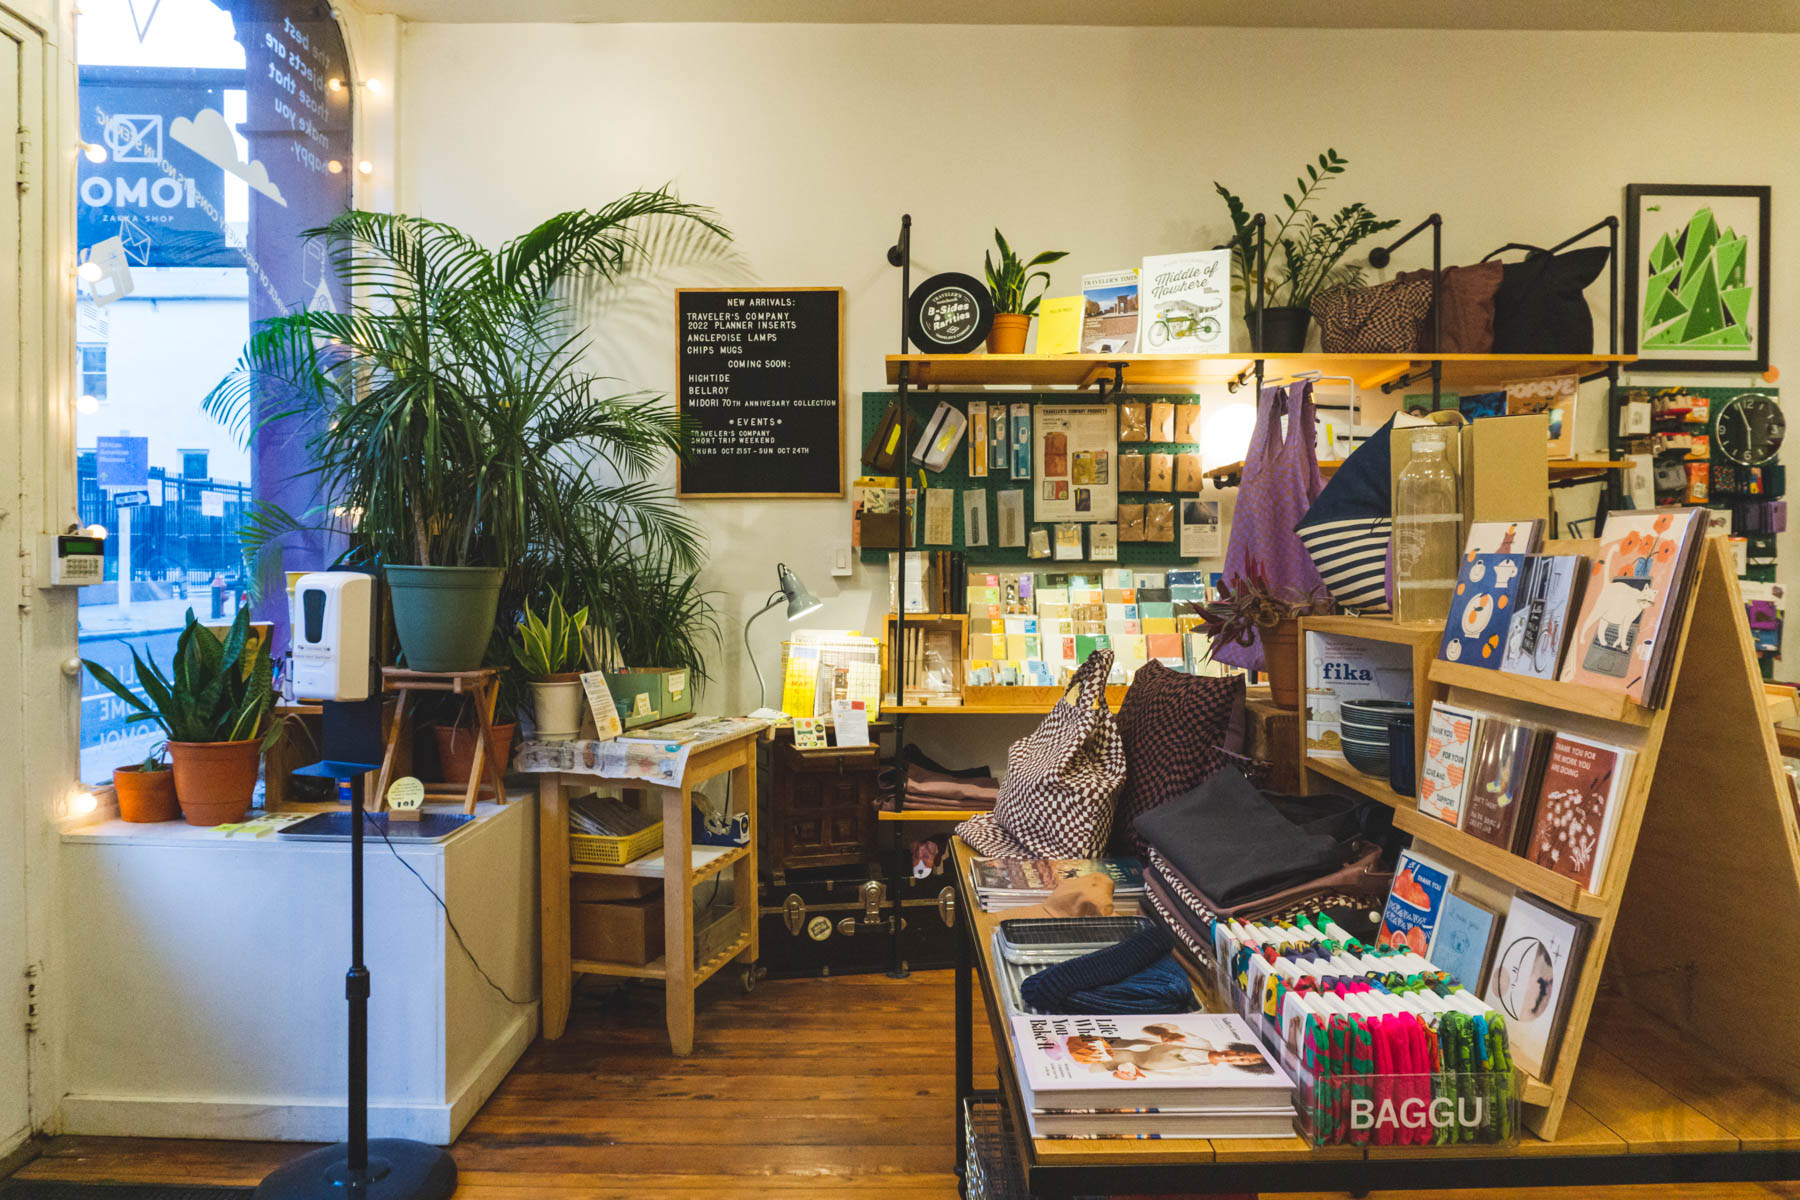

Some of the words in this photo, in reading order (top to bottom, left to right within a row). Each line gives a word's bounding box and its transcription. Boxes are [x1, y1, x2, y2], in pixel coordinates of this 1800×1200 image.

[80, 176, 196, 209] OMOI
[145, 215, 175, 223] SHOP
[1155, 267, 1200, 287] Middle
[1203, 260, 1219, 278] of
[1151, 279, 1208, 299] Nowhere
[727, 298, 746, 307] NEW
[749, 298, 796, 307] ARRIVALS:
[928, 303, 970, 316] B-Sides
[686, 312, 740, 321] TRAVELER'S
[745, 312, 790, 321] COMPANY
[933, 312, 970, 331] Rarities
[687, 321, 709, 330] 2022
[714, 321, 754, 330] PLANNER
[757, 321, 797, 330] INSERTS
[687, 333, 742, 342] ANGLEPOISE
[747, 333, 777, 342] LAMPS
[686, 346, 714, 355] CHIPS
[720, 346, 743, 355] MUGS
[727, 360, 762, 369] COMING
[764, 360, 791, 369] SOON:
[688, 373, 731, 383] HIGHTIDE
[688, 386, 729, 395] BELLROY
[688, 398, 720, 408] MIDORI
[722, 398, 741, 407] 70TH
[744, 400, 791, 408] ANNIVESARY
[793, 399, 837, 407] COLLECTION
[1743, 399, 1754, 409] 12
[1719, 425, 1727, 435] 9
[1771, 425, 1779, 435] 3
[721, 447, 734, 455] OCT
[736, 447, 752, 455] 21ST
[758, 447, 774, 455] SUN
[777, 447, 791, 455] OCT
[792, 447, 809, 455] 24TH
[1744, 450, 1752, 460] 6
[1322, 662, 1373, 681] fika
[1442, 751, 1451, 760] FOR
[1451, 753, 1465, 764] YOUR
[1572, 747, 1584, 757] YOU
[1584, 750, 1596, 760] FOR
[1578, 760, 1591, 770] YOU
[1560, 766, 1579, 778] DOING
[1417, 874, 1432, 886] THANK
[1431, 882, 1442, 892] YOU
[1029, 1019, 1052, 1042] Bake
[1052, 1018, 1069, 1036] You
[1095, 1019, 1119, 1035] Life
[1036, 1042, 1055, 1051] It
[1350, 1096, 1483, 1130] BAGGU
